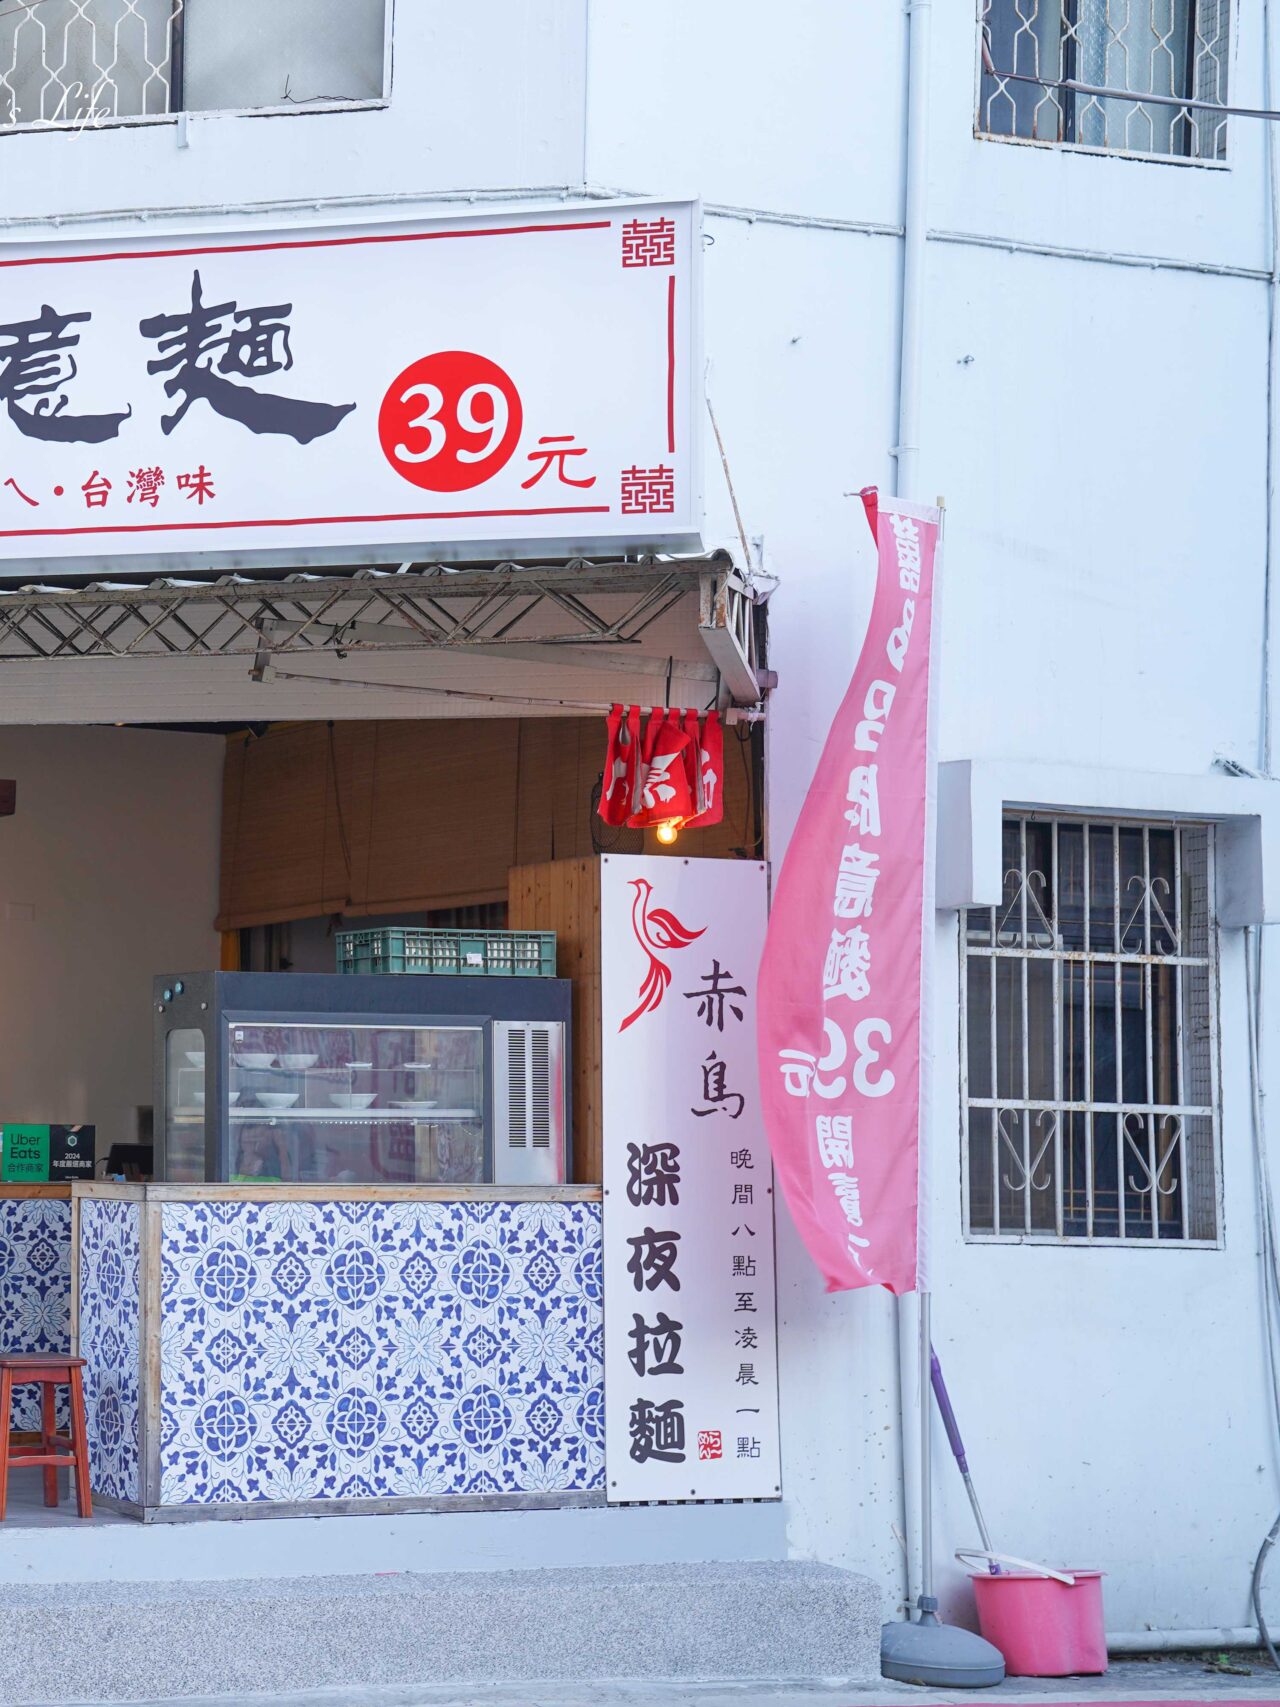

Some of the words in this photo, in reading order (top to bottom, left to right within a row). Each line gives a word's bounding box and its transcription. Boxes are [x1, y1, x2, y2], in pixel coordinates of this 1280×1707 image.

[10, 1134, 41, 1146] Uber
[10, 1147, 41, 1159] Eats
[626, 1142, 686, 1464] 深夜拉麵
[730, 1148, 761, 1459] 晚間八點至凌晨一點
